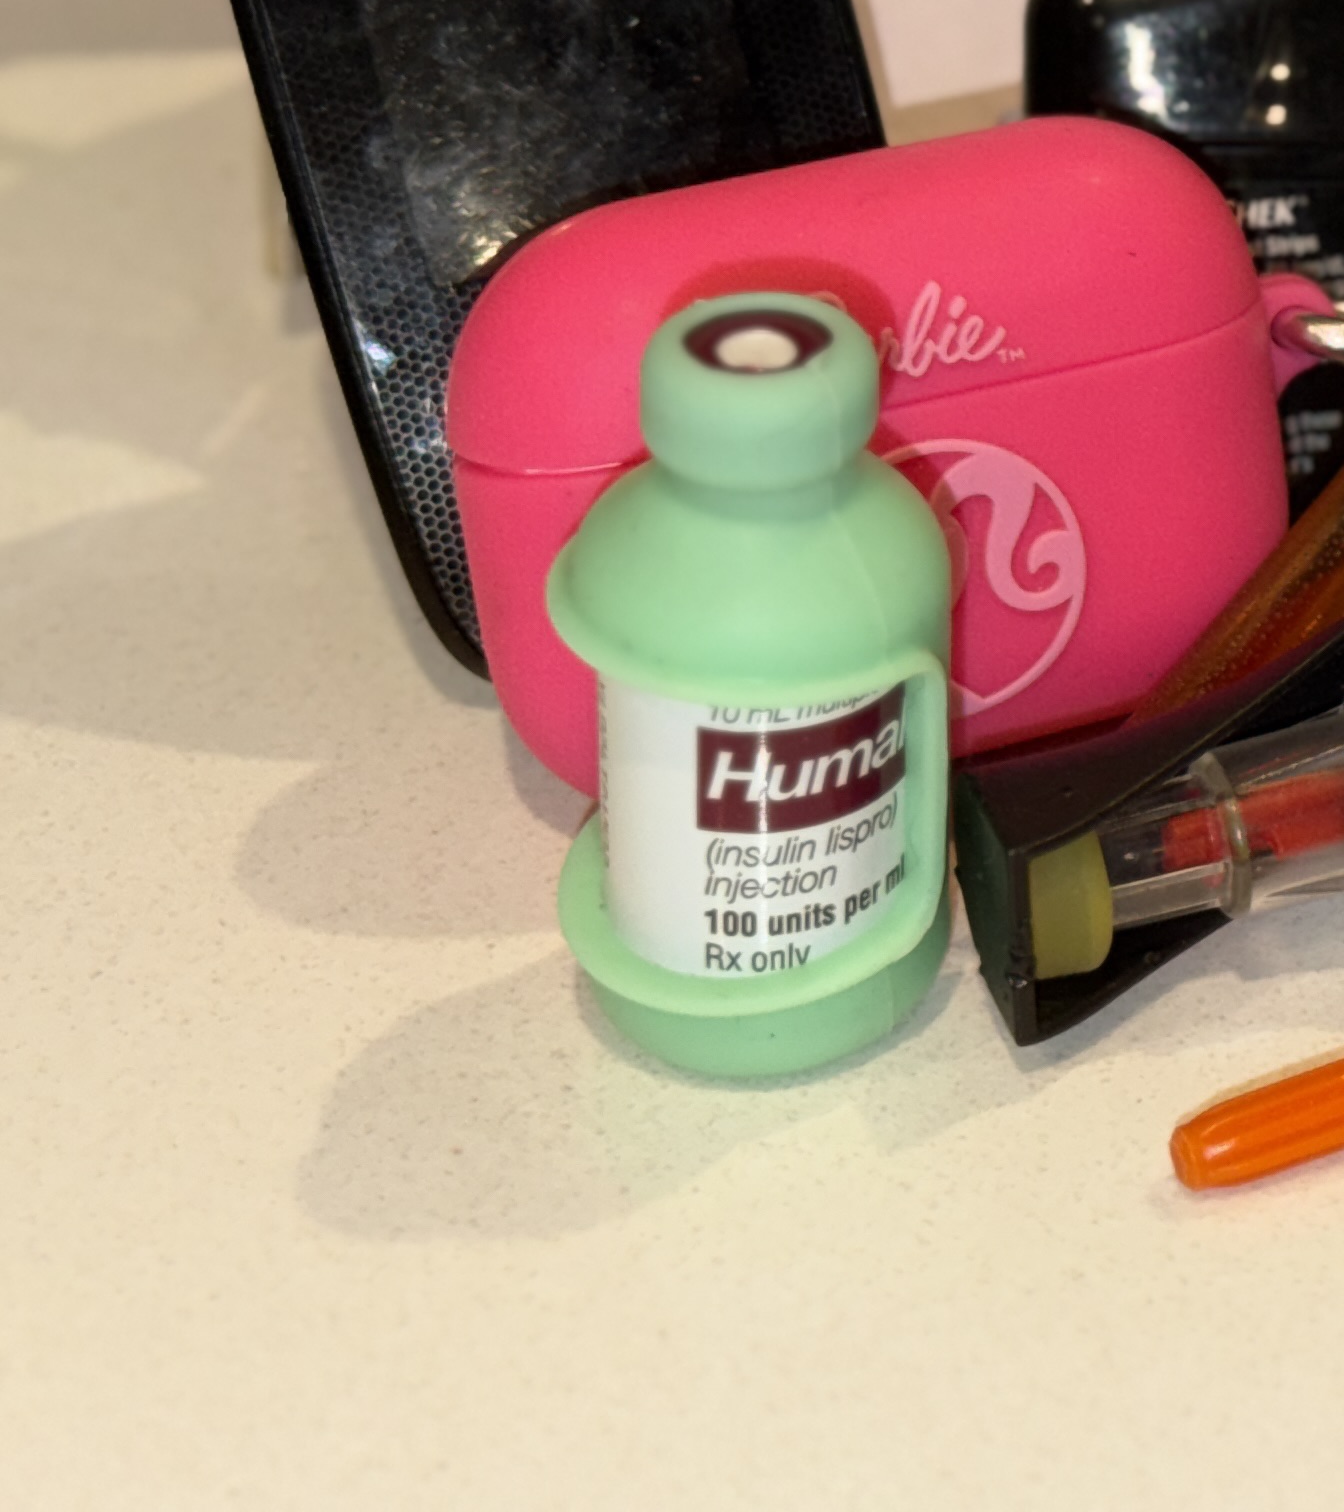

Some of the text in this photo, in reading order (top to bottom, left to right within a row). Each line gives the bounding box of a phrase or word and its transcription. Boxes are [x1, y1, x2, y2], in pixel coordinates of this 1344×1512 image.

[706, 718, 906, 803] Huma
[705, 792, 898, 872] (insulin lispro)
[704, 864, 838, 905] injection
[704, 908, 757, 937] 100
[768, 900, 836, 935] units
[844, 882, 879, 924] per
[704, 942, 812, 973] Rx only
